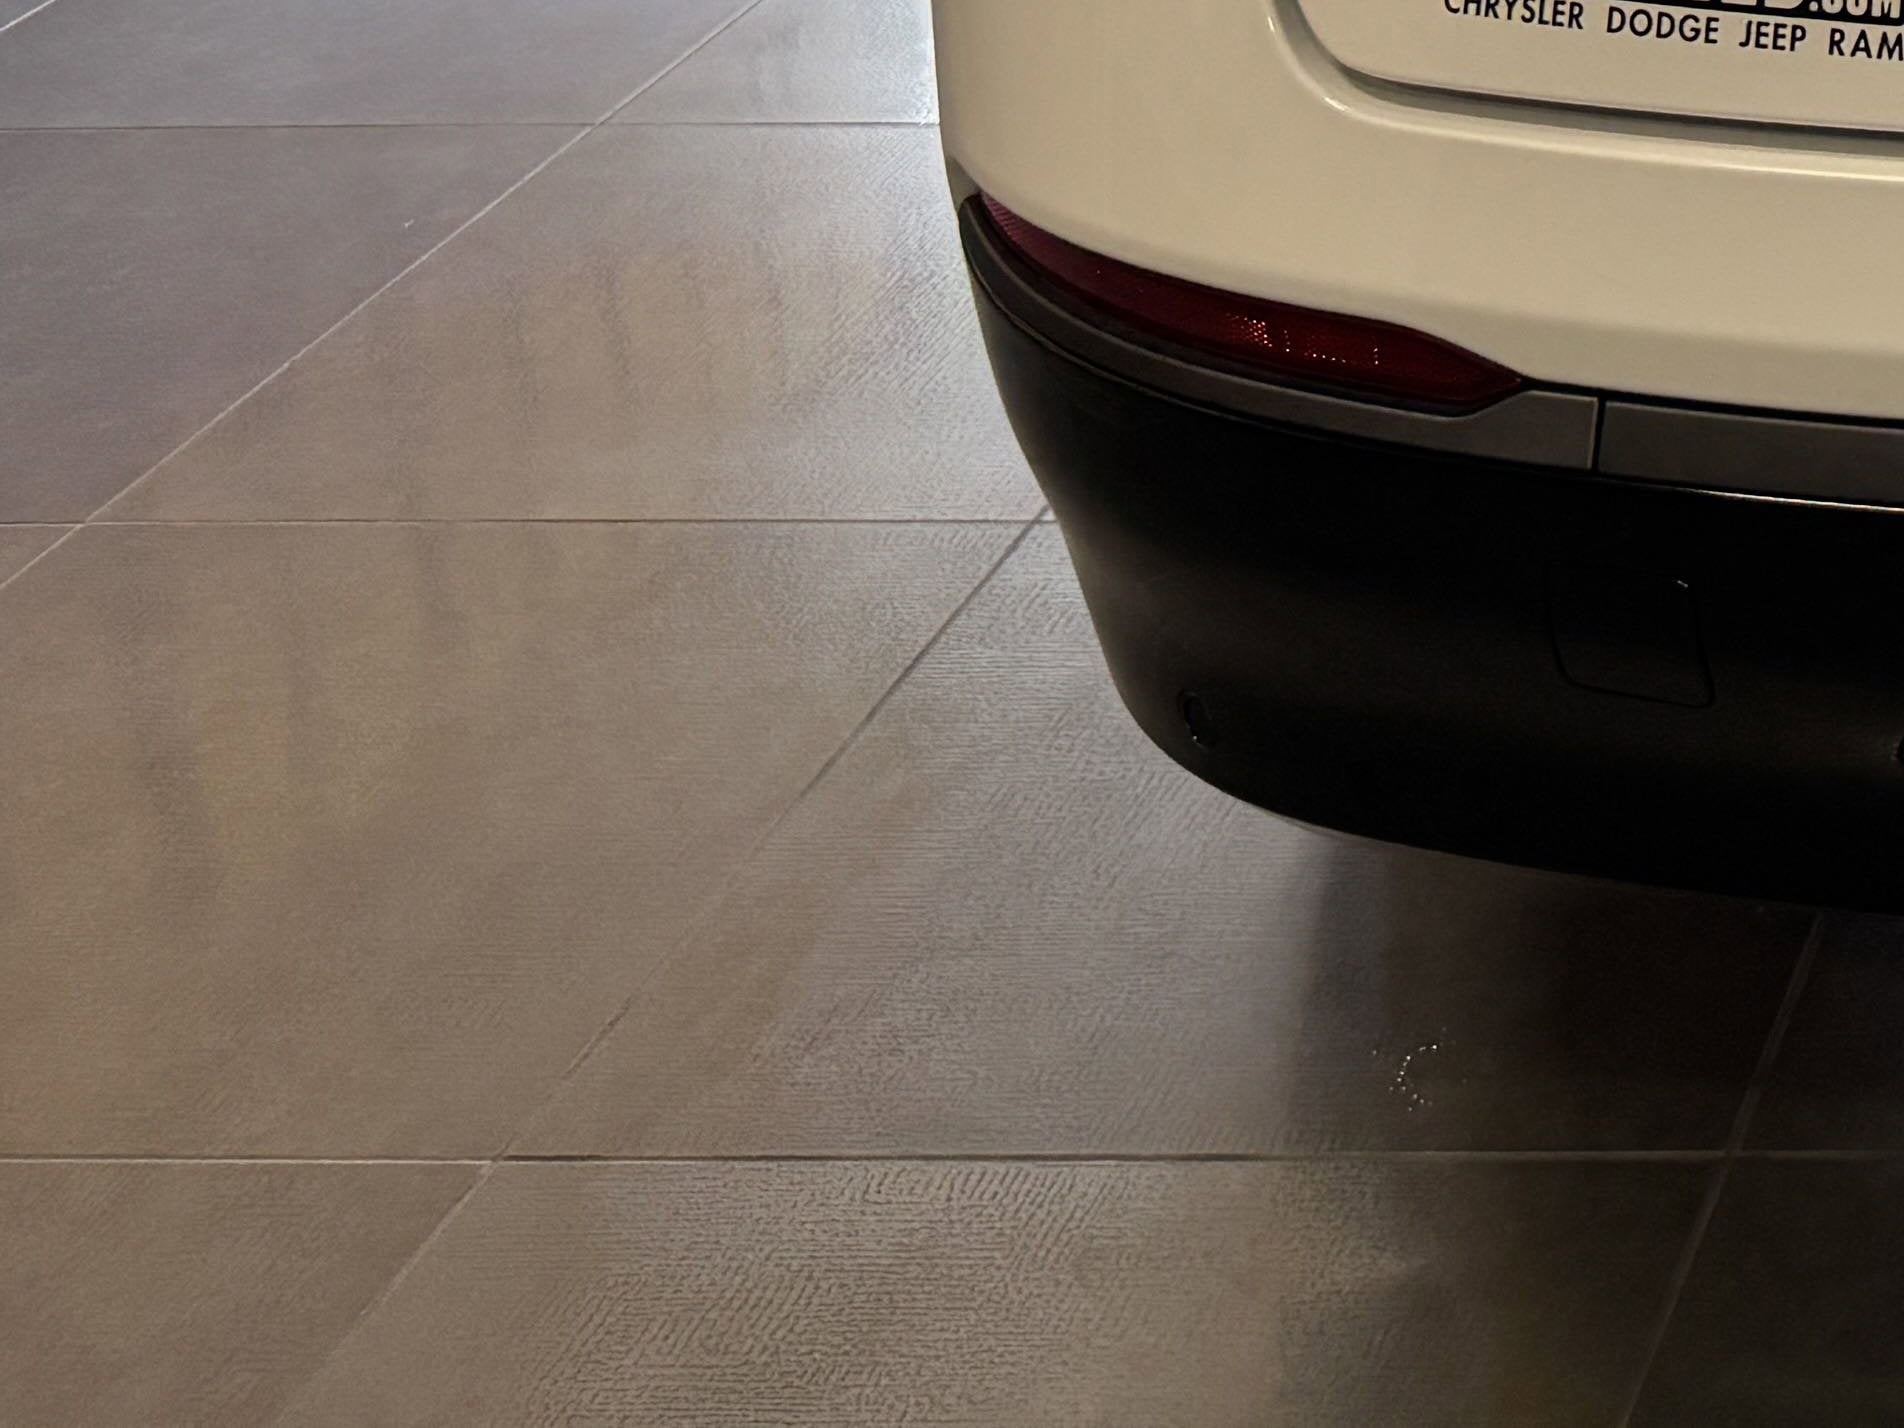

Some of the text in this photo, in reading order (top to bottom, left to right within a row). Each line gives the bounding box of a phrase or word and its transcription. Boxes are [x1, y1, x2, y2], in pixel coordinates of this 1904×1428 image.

[1606, 6, 1719, 44] DODGE
[1739, 19, 1807, 53] JEEP
[1828, 28, 1904, 61] RAM
